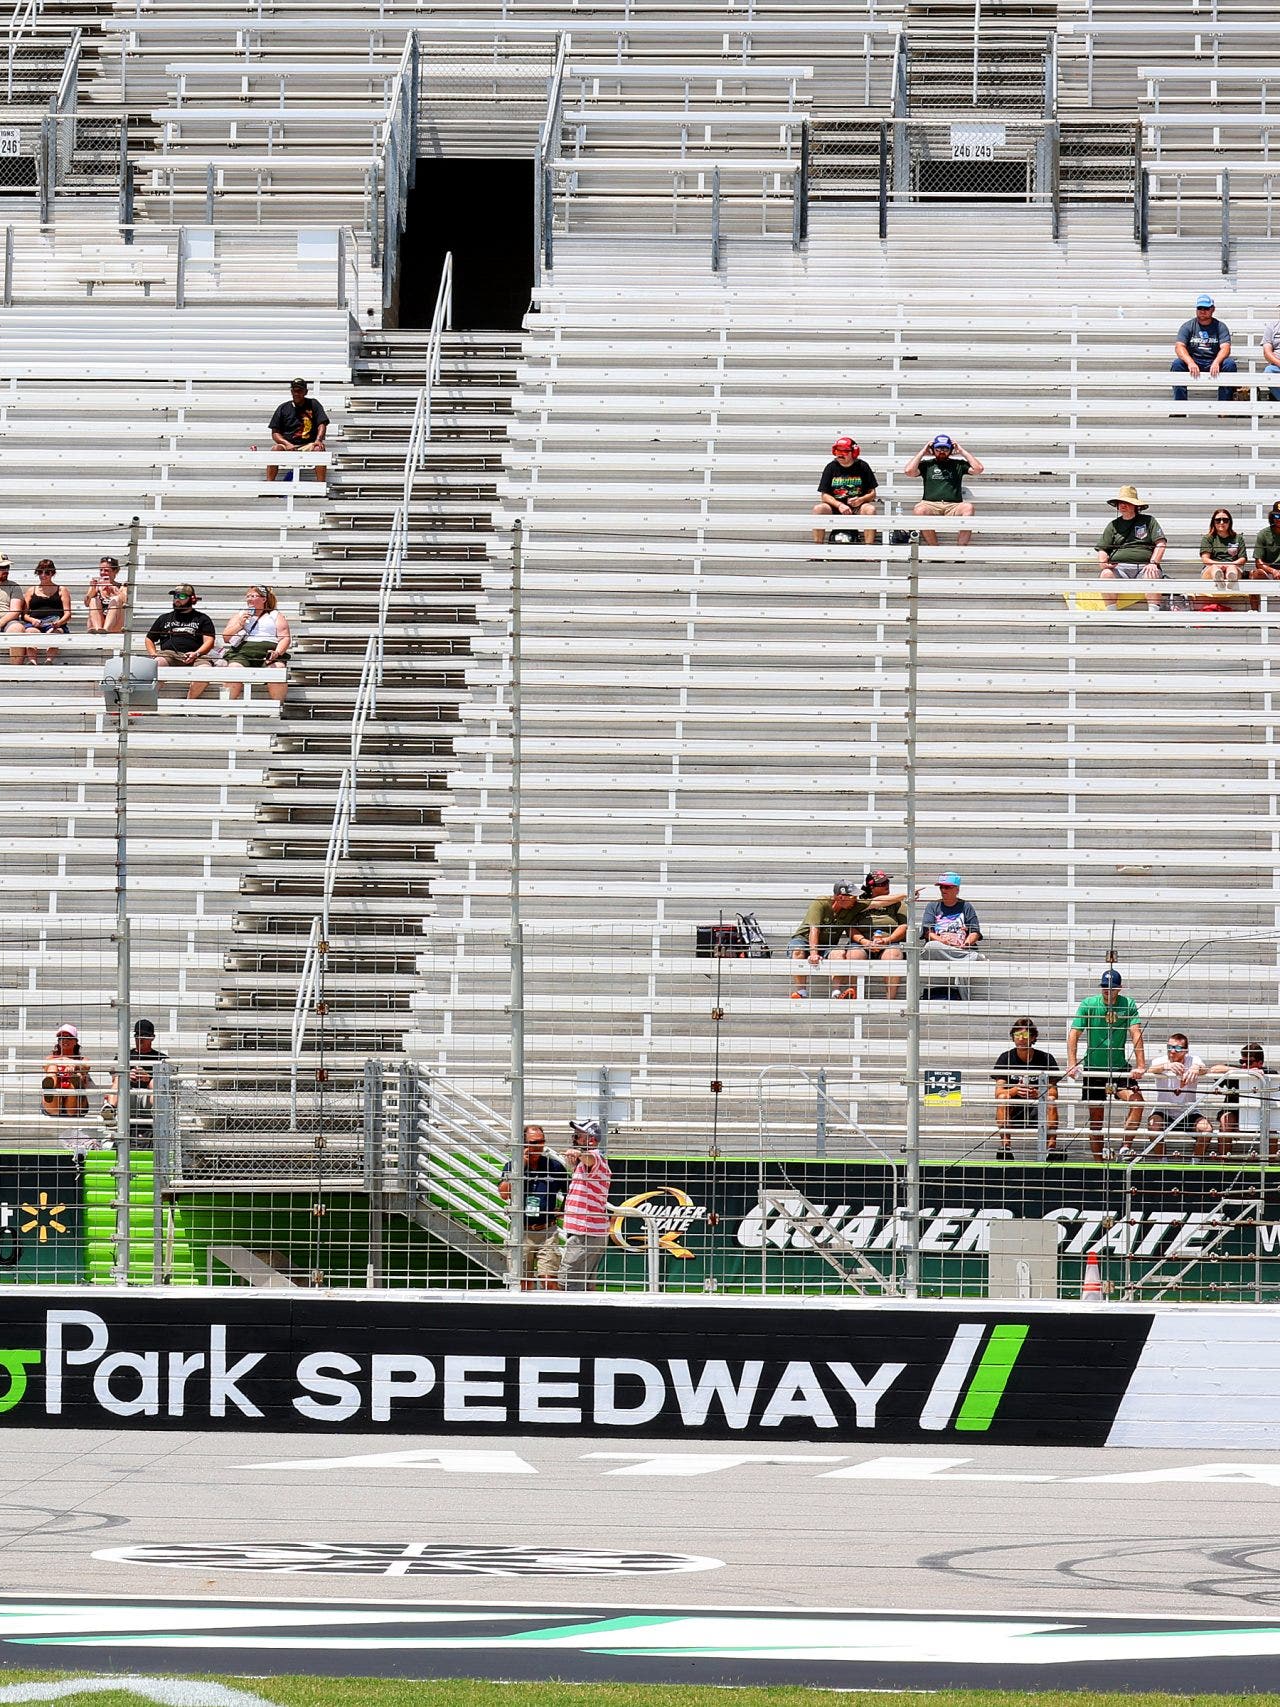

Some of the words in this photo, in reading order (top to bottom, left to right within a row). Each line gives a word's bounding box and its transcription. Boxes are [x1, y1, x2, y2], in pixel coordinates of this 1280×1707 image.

[1, 140, 17, 153] 246
[954, 145, 971, 157] 246
[975, 146, 991, 157] 245
[929, 1076, 956, 1088] 145
[637, 1202, 707, 1219] QUAKER
[292, 1352, 907, 1430] SPEEDWAY
